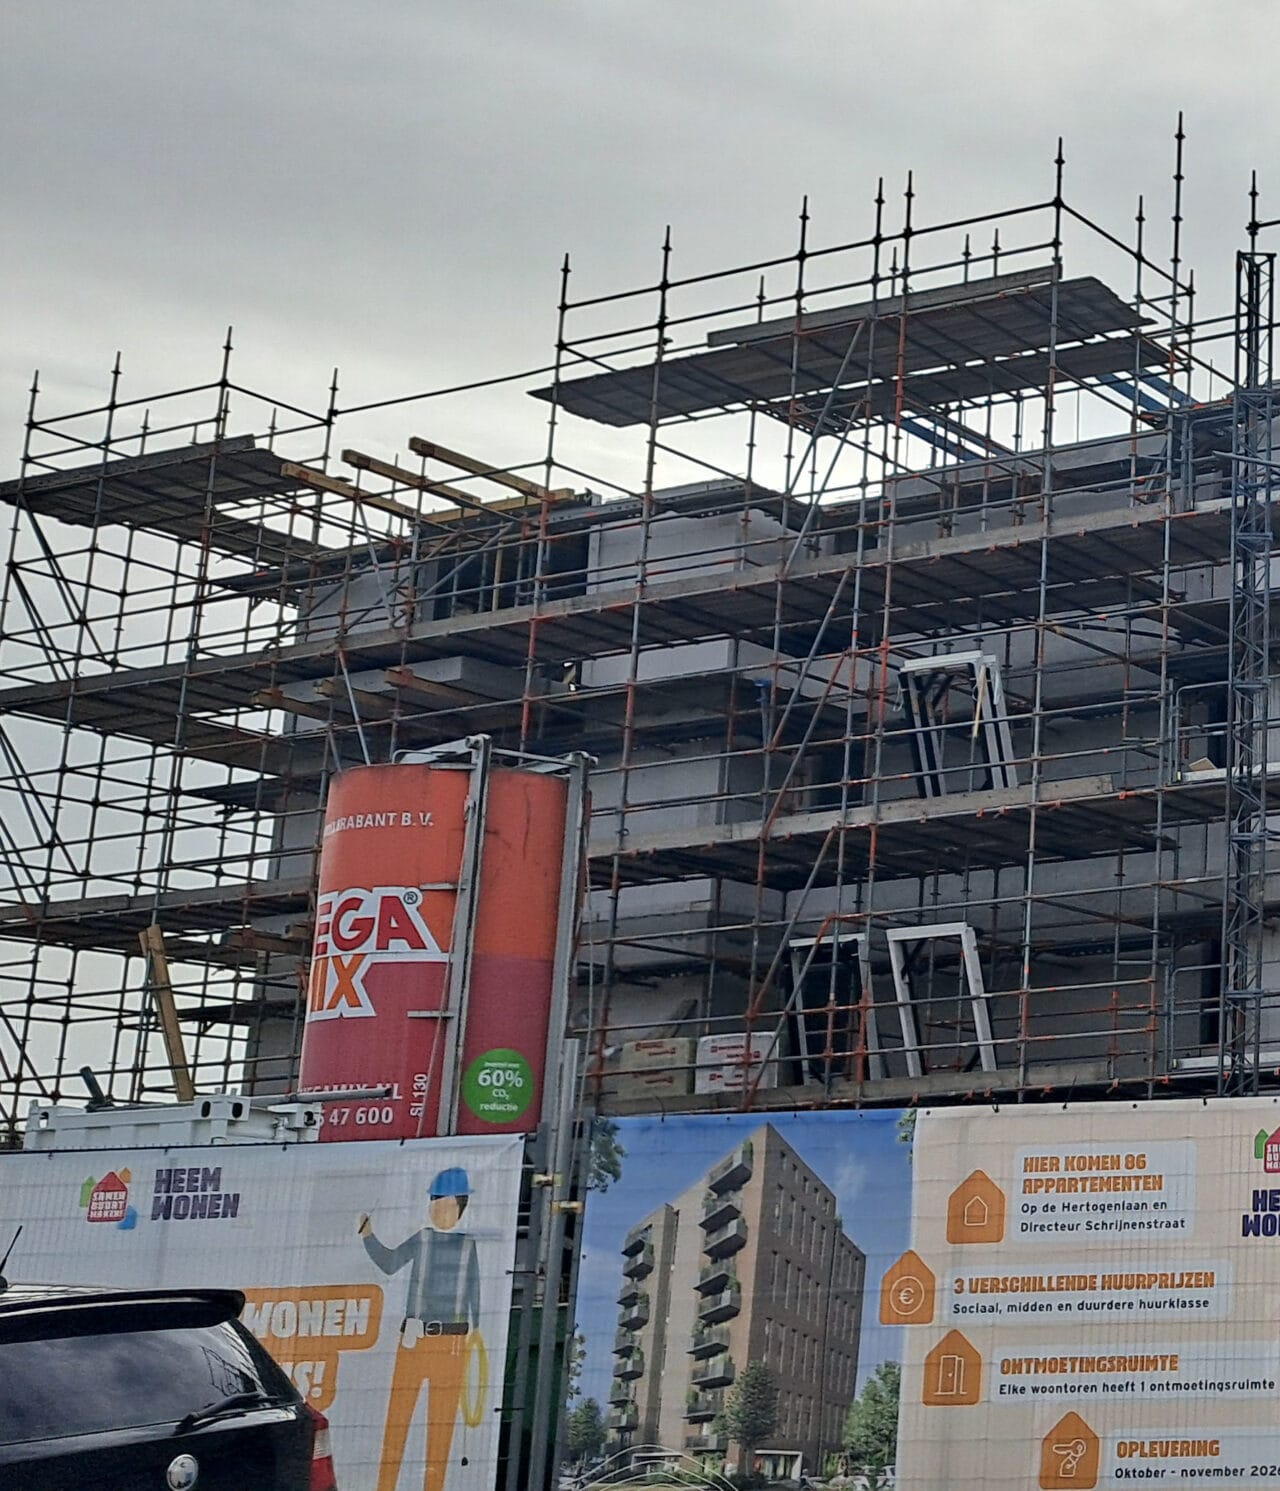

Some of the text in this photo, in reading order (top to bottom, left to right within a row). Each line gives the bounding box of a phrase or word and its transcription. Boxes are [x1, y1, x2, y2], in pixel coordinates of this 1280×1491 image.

[316, 895, 429, 955] EGA
[478, 1069, 523, 1087] 60%
[329, 1108, 351, 1126] 47
[356, 1107, 394, 1125] 600
[1023, 1153, 1147, 1173] HIER KOMEN 86
[154, 1167, 222, 1194] HEEM
[1022, 1175, 1164, 1194] APPARTEMENTEN
[151, 1193, 240, 1220] WONEN
[1021, 1200, 1167, 1215] Op de Hertogenlaan en
[1020, 1218, 1186, 1232] Directeur Schrijnenstraat
[954, 1271, 1214, 1294] 3 VERSCHILLENDE HUURPRIJZEN
[953, 1298, 1209, 1314] Sociaal, midden en duurdere huurklasse
[239, 1298, 370, 1338] WONEN
[1000, 1354, 1178, 1375] ONTMOETINGSRUIMTE
[999, 1384, 1026, 1395] Elke
[1031, 1382, 1097, 1394] woontoren
[1102, 1381, 1136, 1393] heeft
[1150, 1379, 1275, 1392] ontmoetingsruimte
[1117, 1439, 1220, 1458] OPLEVERING
[1115, 1467, 1166, 1479] Oktober
[1181, 1466, 1245, 1477] november
